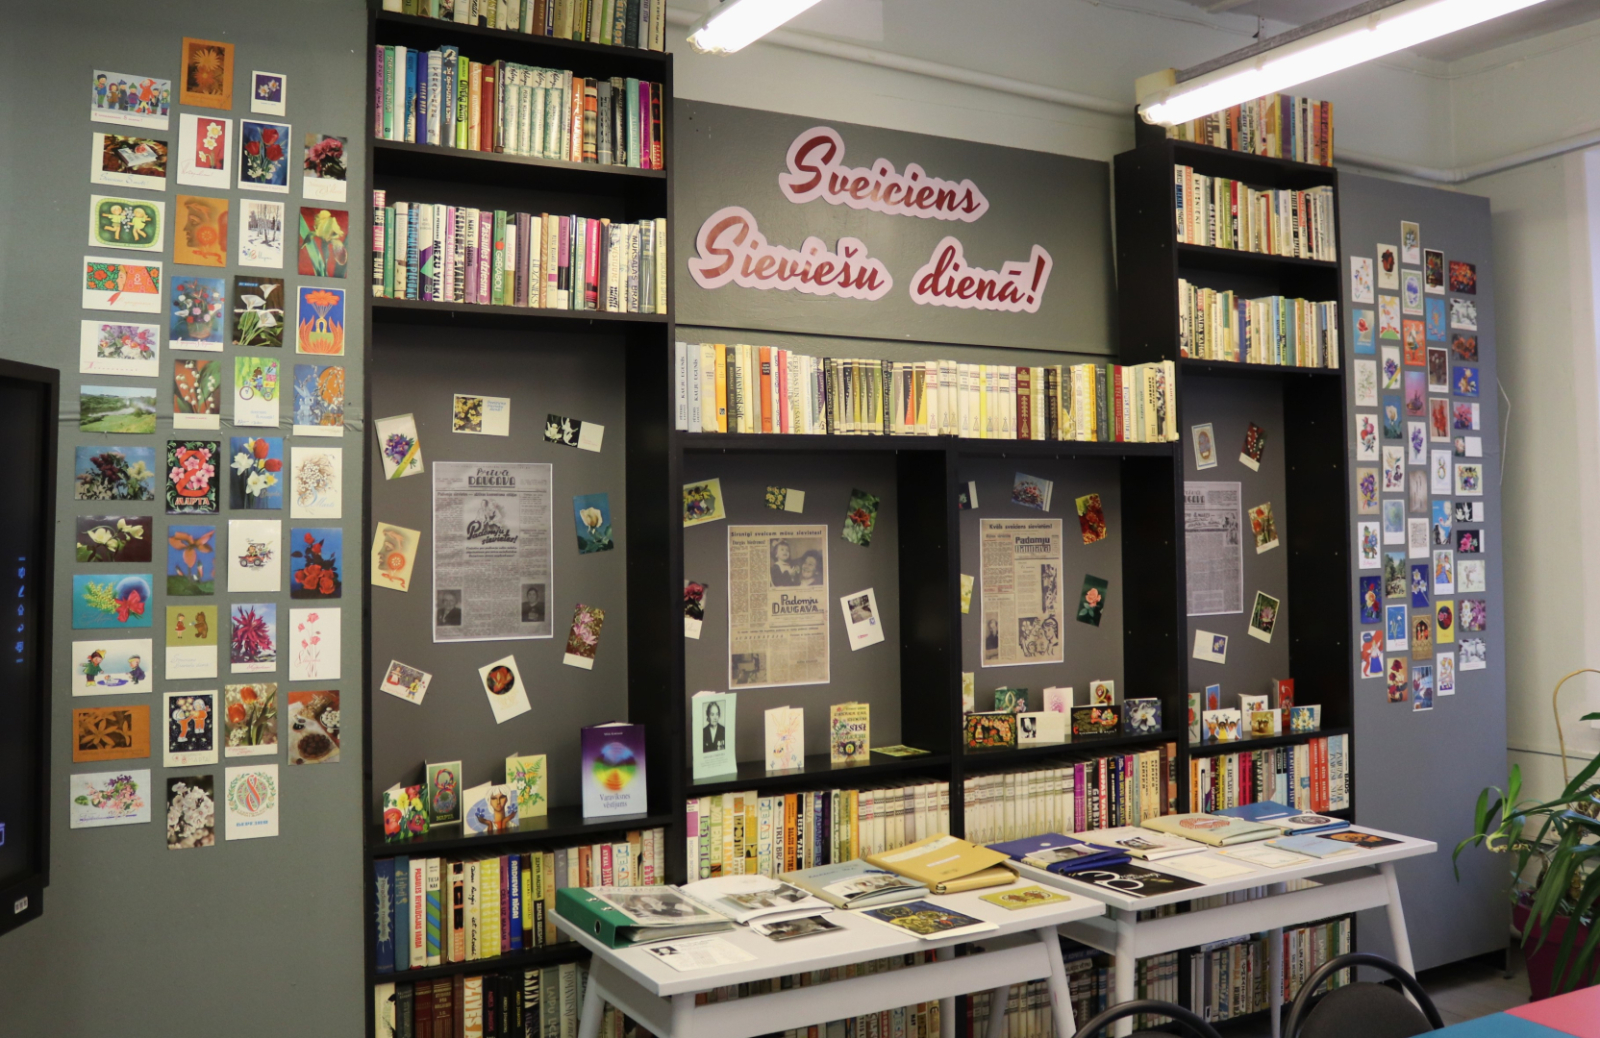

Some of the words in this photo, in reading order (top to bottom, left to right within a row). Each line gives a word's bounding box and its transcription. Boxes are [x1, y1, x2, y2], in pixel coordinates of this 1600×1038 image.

[788, 135, 981, 214] Sveiciens
[480, 222, 491, 259] Pasaules
[699, 215, 885, 292] Sieviešu
[917, 244, 1046, 305] dienā!
[480, 260, 490, 296] dziesma
[794, 387, 800, 398] UN
[468, 476, 516, 486] DAUGAVA
[175, 497, 210, 506] МАРТА
[1015, 536, 1050, 544] Padomju
[772, 602, 818, 615] DAUGAVA
[780, 594, 818, 606] Padomju
[512, 860, 520, 897] ARDIEVAS
[501, 907, 506, 916] UZ
[512, 898, 520, 919] RĪGAI
[547, 986, 556, 1014] LAIPU
